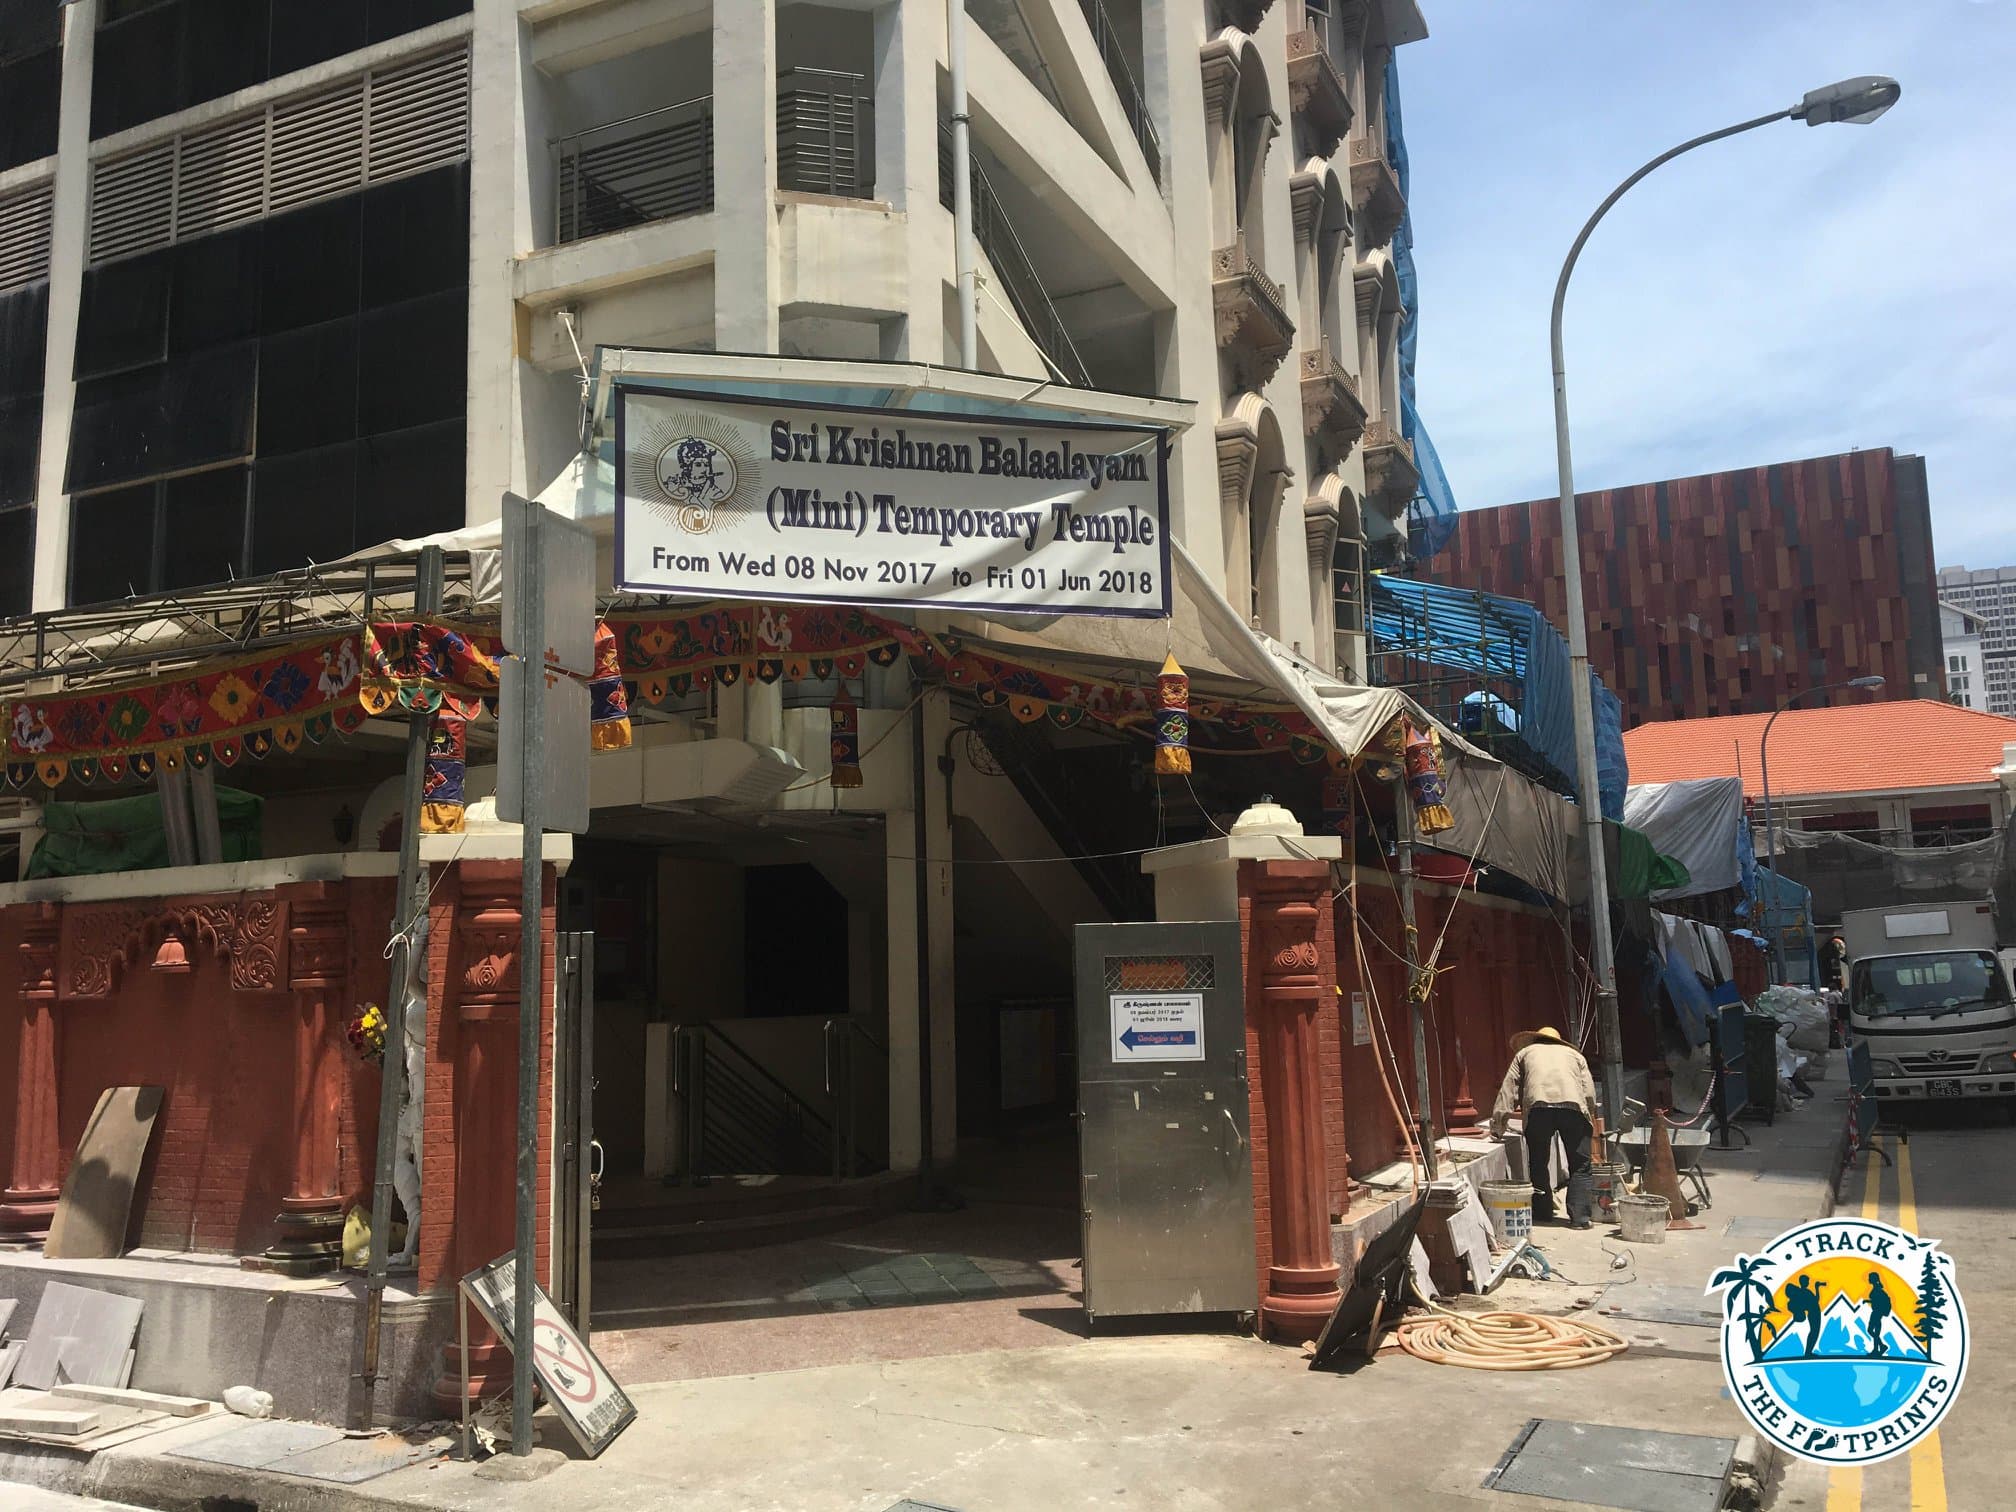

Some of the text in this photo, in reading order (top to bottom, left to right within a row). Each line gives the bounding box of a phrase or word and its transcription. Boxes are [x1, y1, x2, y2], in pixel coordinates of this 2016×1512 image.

[771, 419, 1150, 490] Sri Krishnan Balaalayam
[766, 485, 1154, 554] (Mini) Temporary Temple
[653, 546, 1153, 594] From Wed 08 Nov 2017 to Fri 01 Jun 2018
